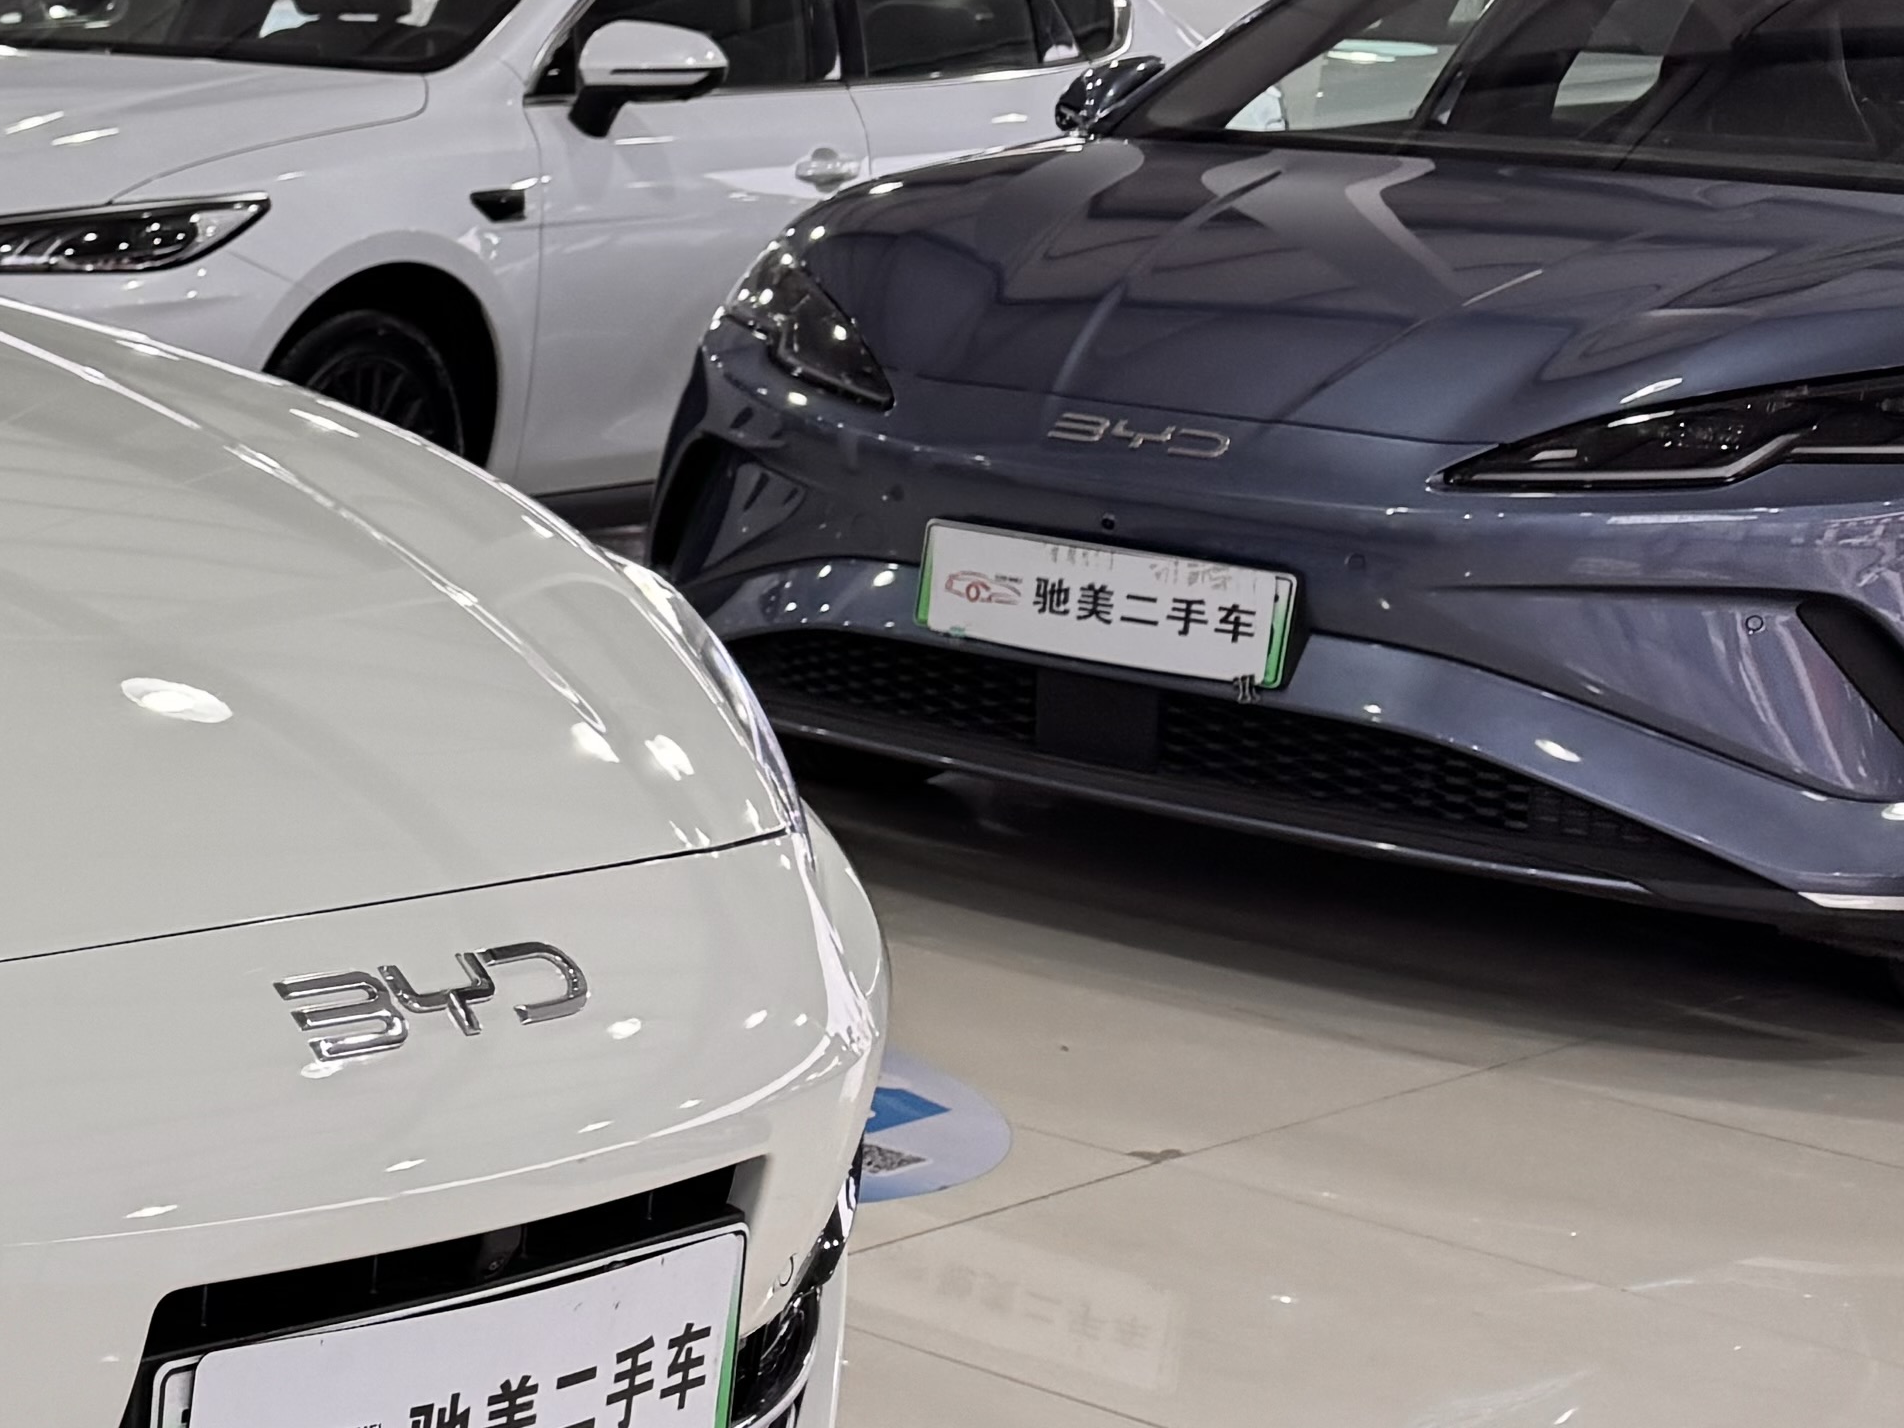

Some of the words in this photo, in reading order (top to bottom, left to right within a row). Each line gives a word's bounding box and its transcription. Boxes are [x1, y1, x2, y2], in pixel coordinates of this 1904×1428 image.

[1047, 412, 1230, 458] BYD
[1033, 576, 1257, 643] 驰美二手车
[272, 941, 590, 1062] BYD
